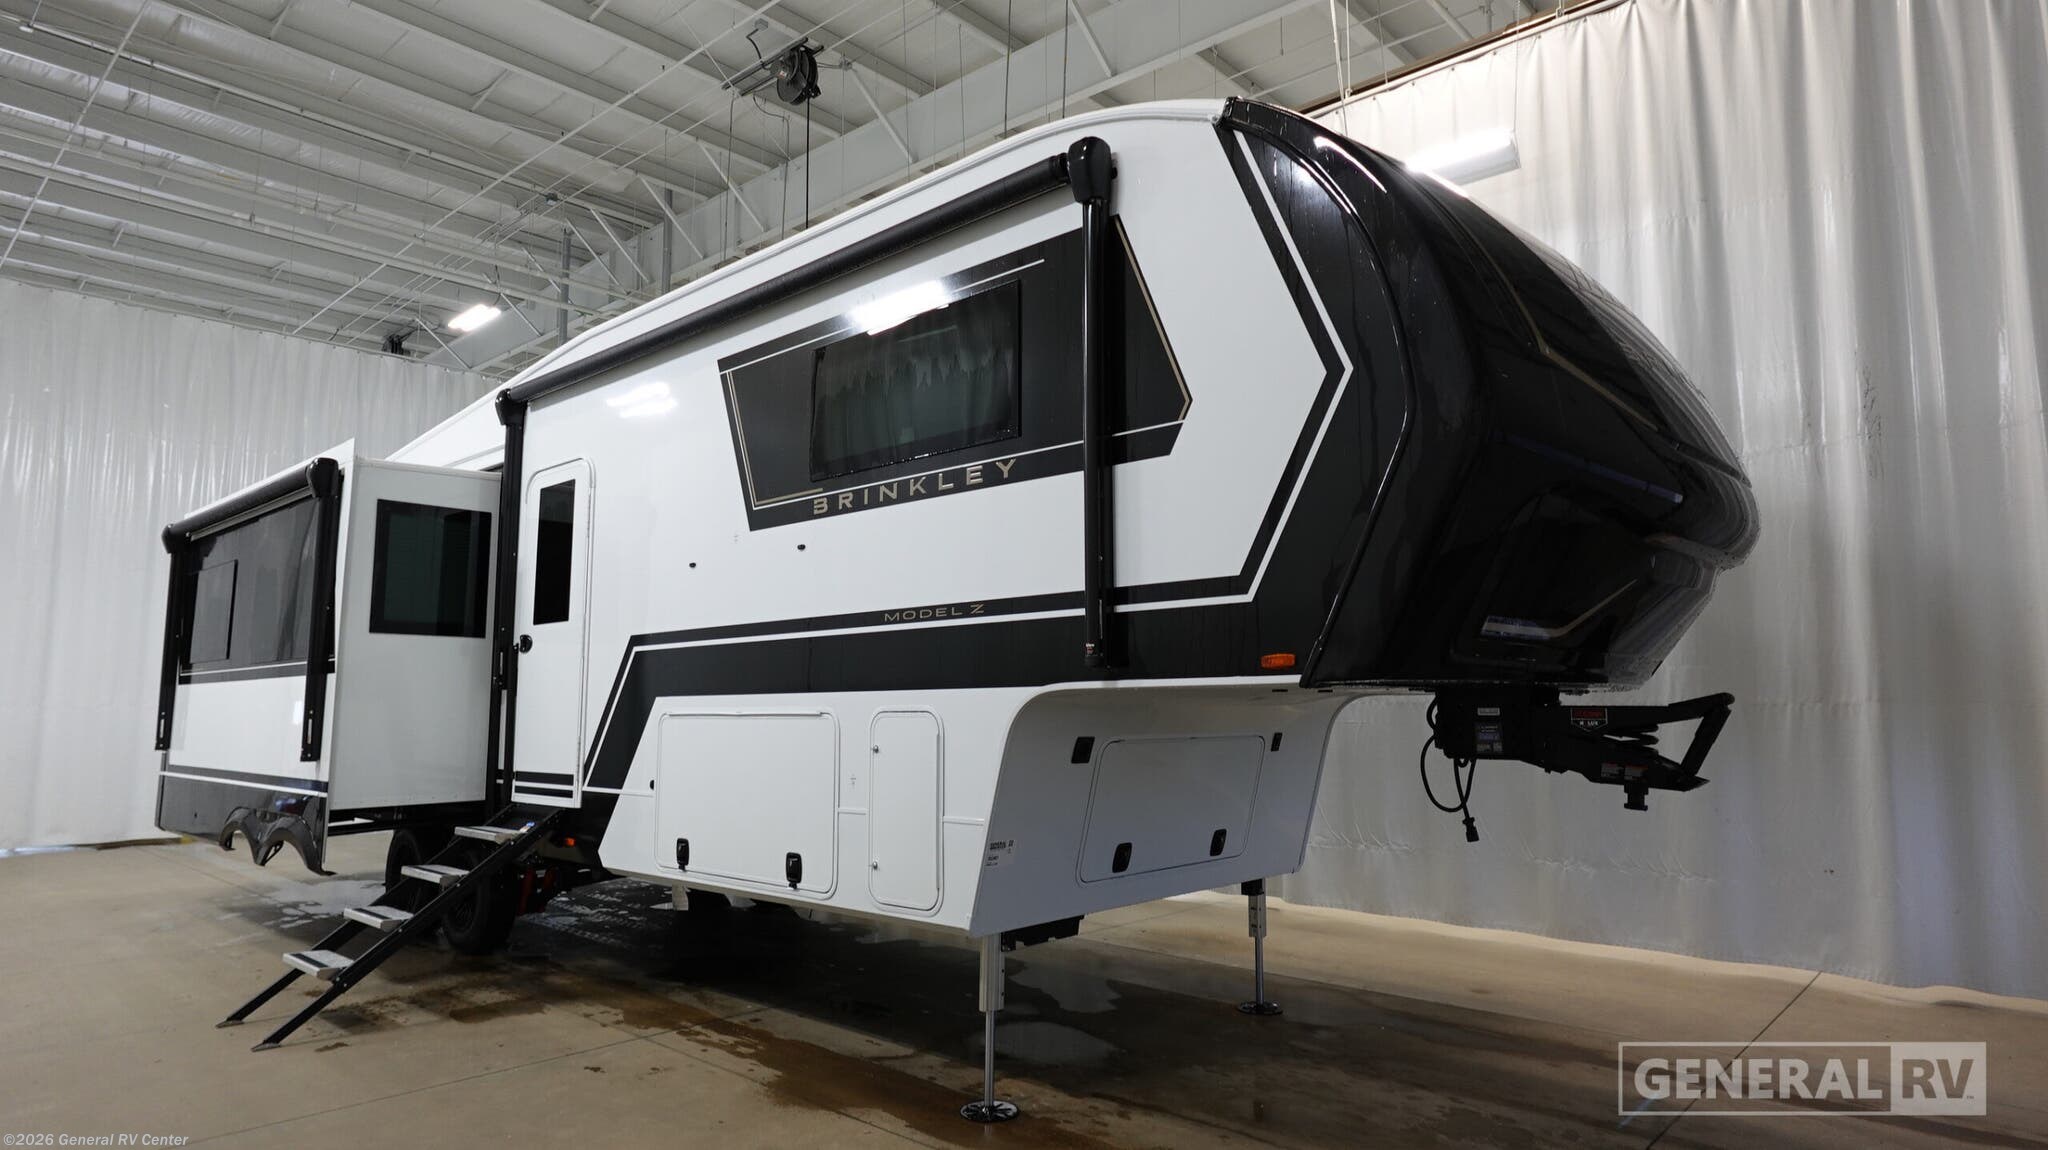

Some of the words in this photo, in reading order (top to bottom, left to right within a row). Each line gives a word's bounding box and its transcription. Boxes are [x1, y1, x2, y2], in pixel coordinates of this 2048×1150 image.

[813, 458, 1017, 515] BRINKLEY
[884, 606, 963, 622] MODEL
[970, 603, 985, 614] Z
